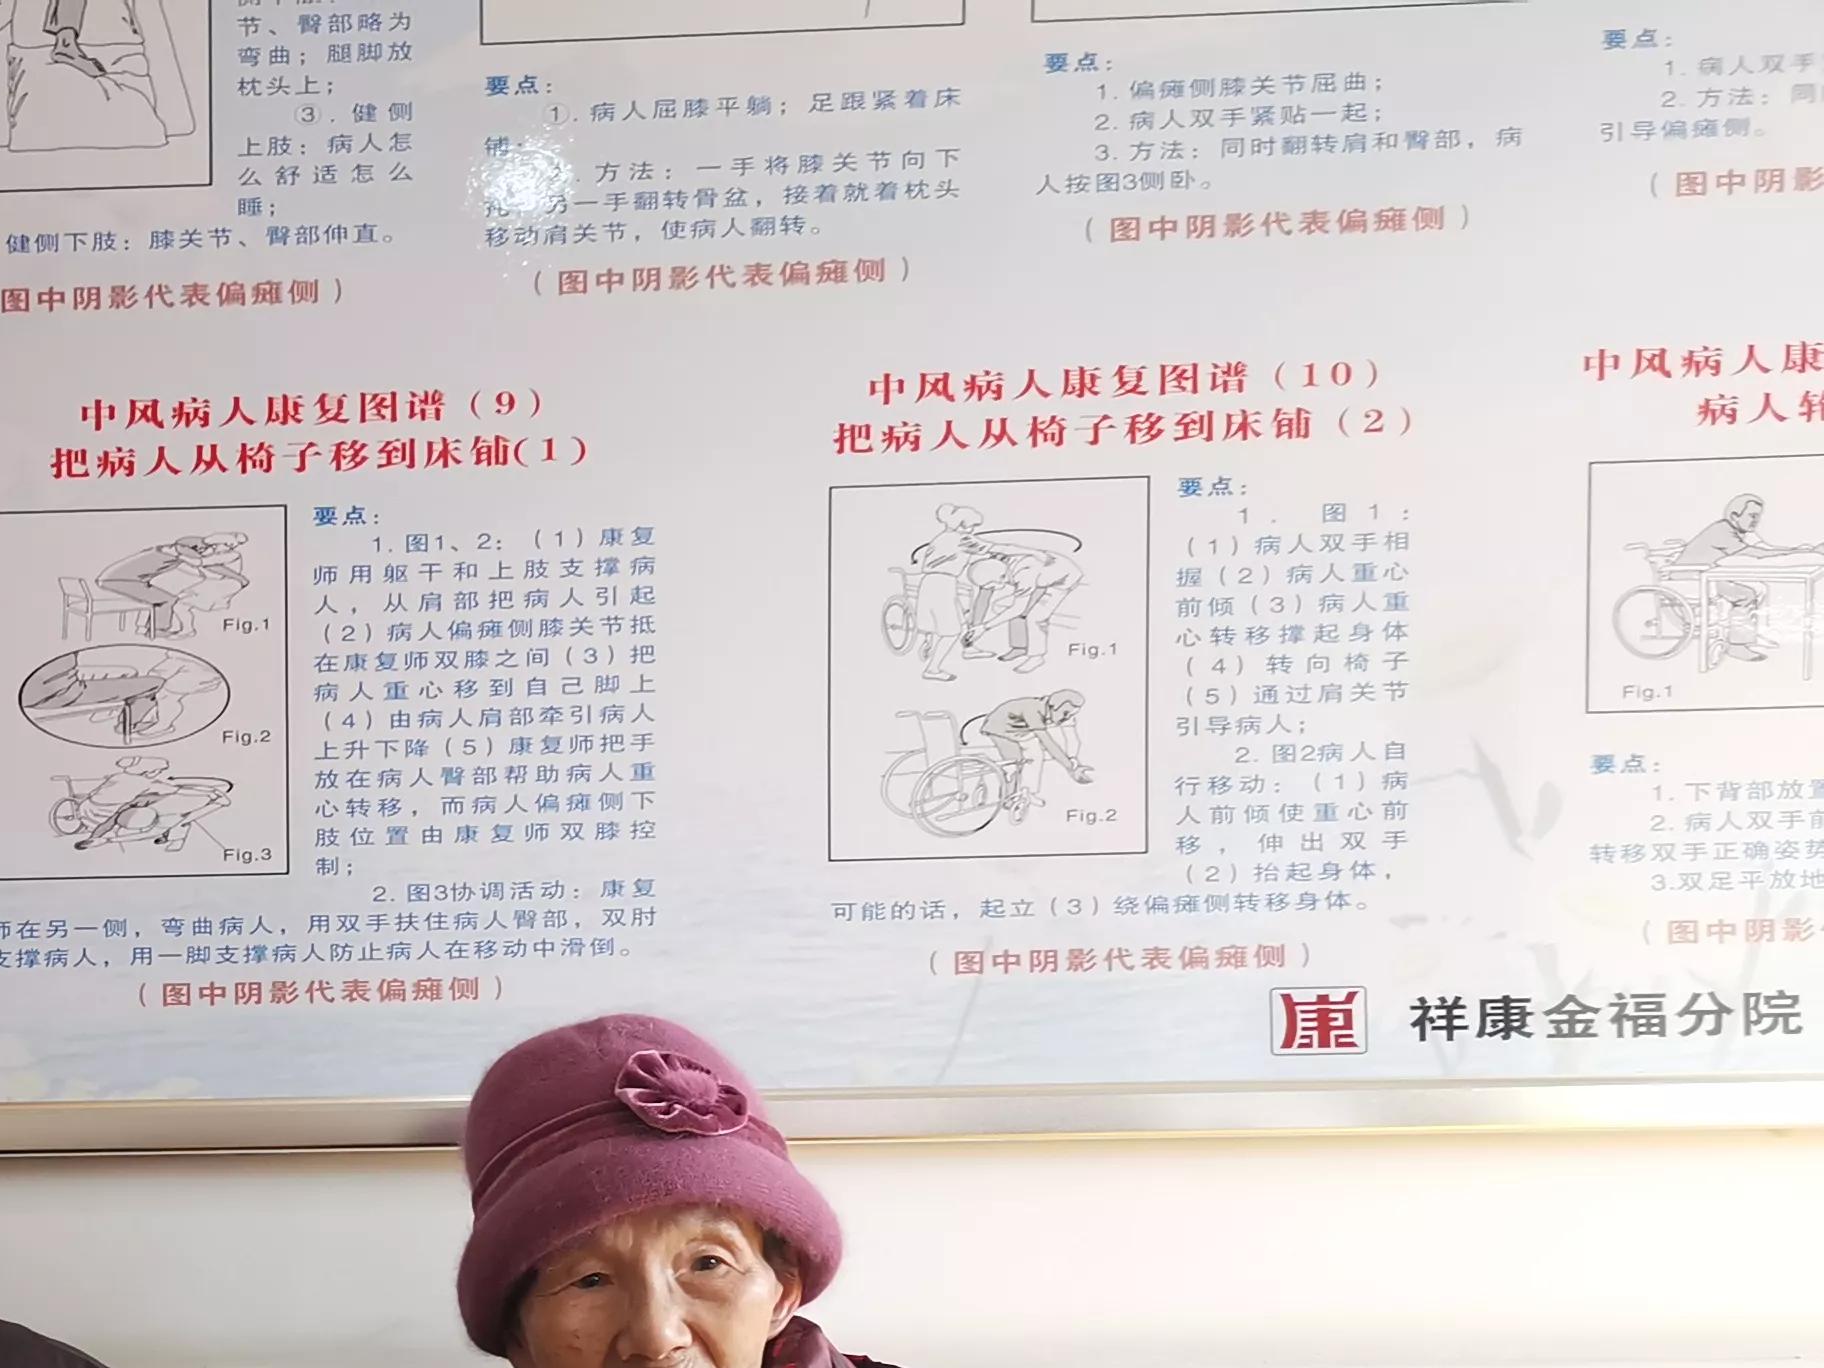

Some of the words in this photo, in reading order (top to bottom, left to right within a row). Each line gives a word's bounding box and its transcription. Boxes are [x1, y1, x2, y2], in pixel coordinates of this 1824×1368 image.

[1602, 29, 1672, 50] 要点：
[1044, 52, 1114, 74] 要点：
[1664, 52, 1824, 76] 1.病人双手
[485, 75, 552, 96] 要点：
[238, 161, 413, 187] 么舒适怎么
[1583, 341, 1824, 381] 中风病人康
[868, 359, 1380, 405] 中风病人康复图谱（10）
[80, 388, 545, 431] 中风病人康复图谱（9）
[1178, 477, 1248, 498] 要点：
[313, 504, 380, 527] 要点：
[314, 554, 655, 586] 师用躯干和上肢支撑病
[223, 615, 270, 634] Fig.1
[1177, 621, 1410, 646] 心转移撑起身体
[1068, 641, 1117, 660] Fig.1
[314, 674, 655, 702] 病人重心移到自己脚上
[222, 727, 271, 746] Fig.2
[1235, 741, 1405, 765] 2.图2病人自
[314, 761, 655, 791] 放在病人臀部帮助病人重
[1066, 807, 1117, 826] Fig.2
[1176, 799, 1408, 826] 人前倾使重心前
[315, 819, 657, 848] 肢位置由康复师双膝控
[224, 846, 272, 864] Fig.3
[1643, 917, 1824, 946] （图中阴影
[1410, 990, 1804, 1043] 祥康金福分院
